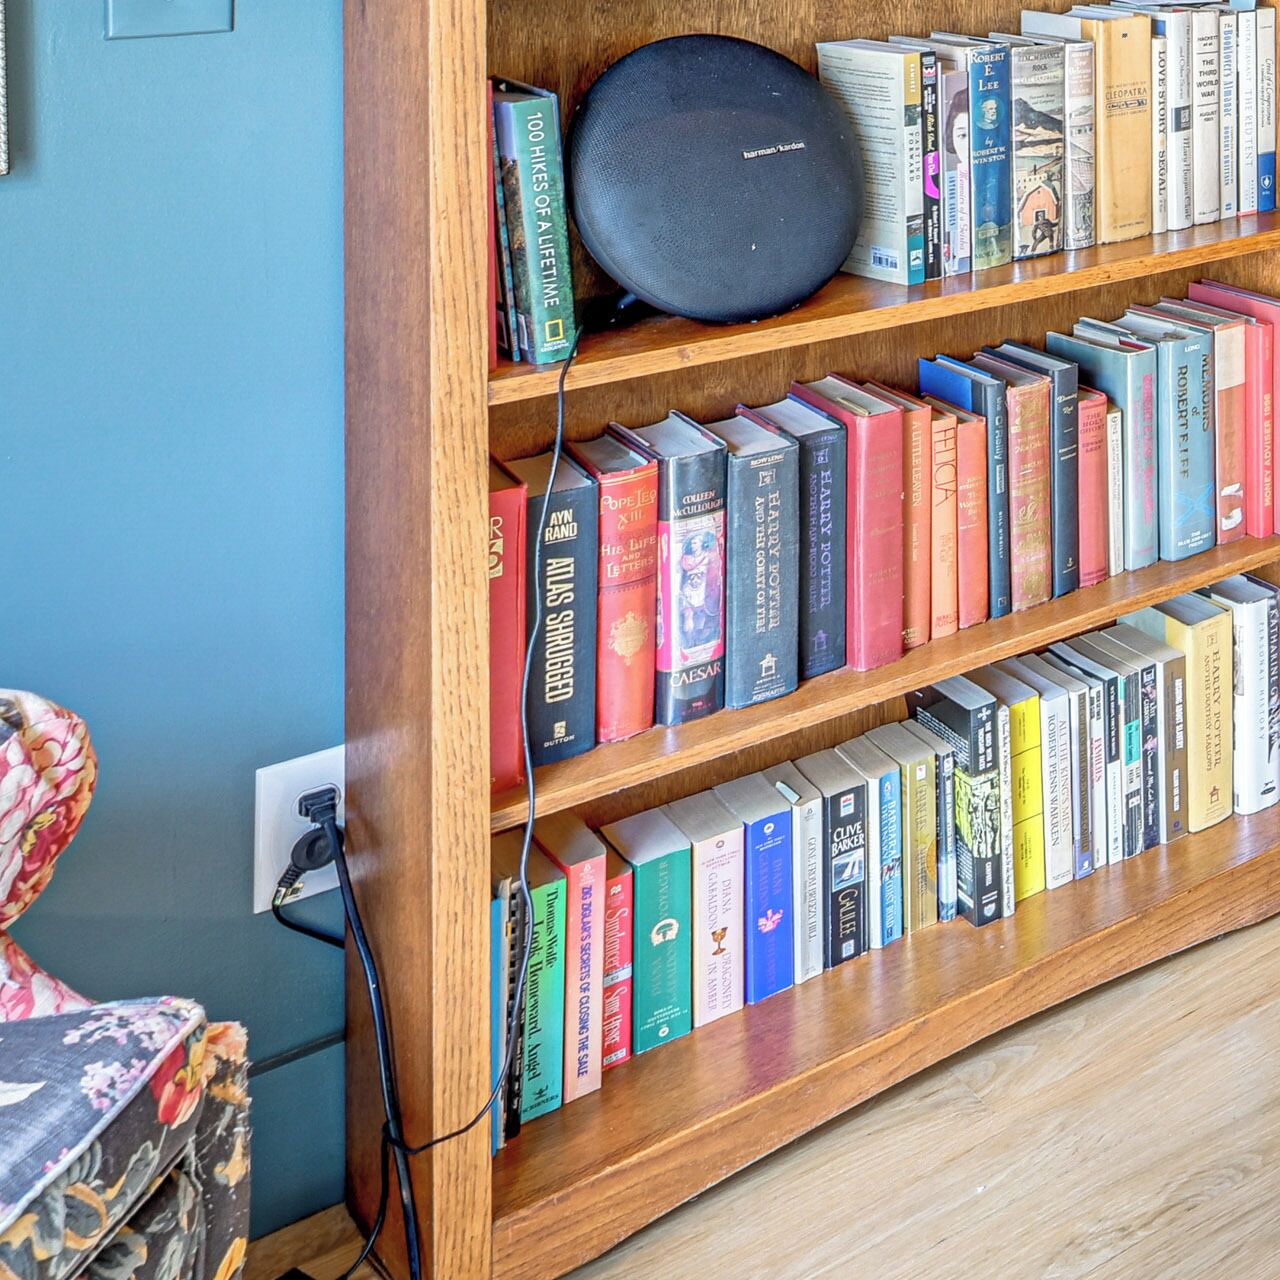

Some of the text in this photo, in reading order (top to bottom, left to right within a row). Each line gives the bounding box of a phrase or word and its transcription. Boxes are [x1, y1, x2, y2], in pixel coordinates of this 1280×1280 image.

[970, 51, 1006, 64] ROBERT
[1202, 58, 1215, 66] THE
[978, 80, 1000, 91] LEE
[1196, 80, 1219, 88] WORLD
[1199, 69, 1218, 78] THIRD
[1105, 87, 1148, 101] CLEOPATRA
[1201, 90, 1216, 98] WAR
[1244, 90, 1253, 112] THE
[1158, 51, 1166, 196] LOVE STORY SEGAL
[1199, 110, 1218, 118] AUGUST
[1244, 114, 1253, 139] RED
[743, 142, 806, 159] harman/kardon
[984, 137, 994, 146] by
[1244, 139, 1253, 168] TENT
[527, 113, 560, 308] 100 HIKES OF A LIFETIME
[1200, 354, 1213, 433] MEMOIRS
[1082, 419, 1102, 428] HOLY
[1086, 412, 1100, 421] THE
[1191, 406, 1200, 416] OF
[933, 426, 957, 508] FELICIA
[601, 488, 657, 515] POPE LEO
[682, 489, 716, 504] COLLEEN
[549, 509, 574, 526] AYN
[545, 522, 578, 542] RAND
[820, 470, 833, 609] HARRY POTTER
[601, 535, 657, 556] HIS LIFE
[621, 551, 641, 562] AND
[607, 555, 654, 578] LETTERS
[768, 490, 781, 631] HARRY POTTER
[545, 557, 575, 705] ATLAS SHRUGGED
[670, 662, 721, 687] CAESAR
[1212, 650, 1222, 768] HARRY POTTER
[543, 734, 575, 748] DUTTON
[1060, 740, 1068, 761] THE
[1048, 714, 1059, 847] ROBERT PENN WARREN
[1061, 763, 1069, 801] KING'S
[833, 821, 862, 842] CLIVE
[881, 804, 890, 859] DELINSKY
[887, 800, 897, 860] BARBARA
[1061, 807, 1070, 833] MEN
[831, 833, 865, 857] BARKER
[658, 861, 669, 918] VOYAGER
[707, 872, 719, 931] GABALDON
[722, 878, 732, 915] DIANA
[838, 888, 858, 939] GALILEE
[546, 887, 559, 969] Thomas Wolfe
[604, 907, 629, 971] Sundancer
[576, 884, 593, 1078] ZIG ZIGLAR'S SECRETS OF CLOSING THE SALE
[707, 961, 717, 1011] IN AMBER
[722, 952, 733, 1010] DRAGONFLY
